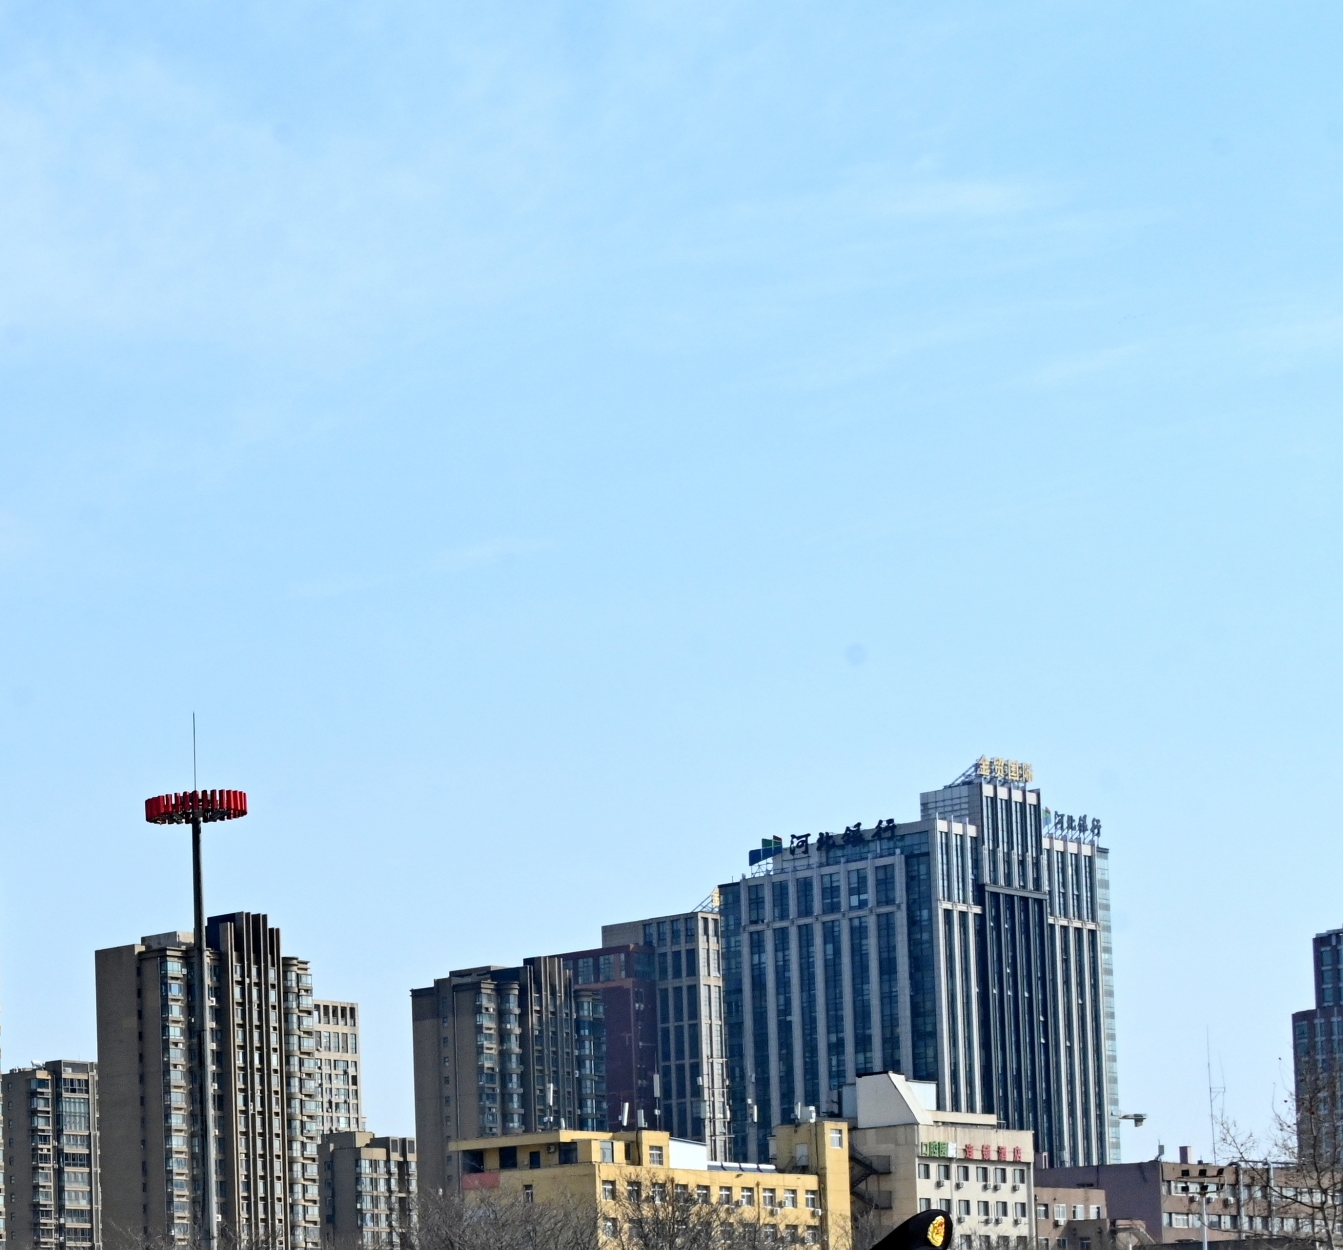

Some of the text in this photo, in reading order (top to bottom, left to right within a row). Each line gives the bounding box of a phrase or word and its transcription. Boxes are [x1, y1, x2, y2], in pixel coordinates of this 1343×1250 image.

[978, 754, 1033, 783] 金贸国际
[790, 818, 897, 856] 河北银行
[1055, 811, 1101, 838] 河北银行
